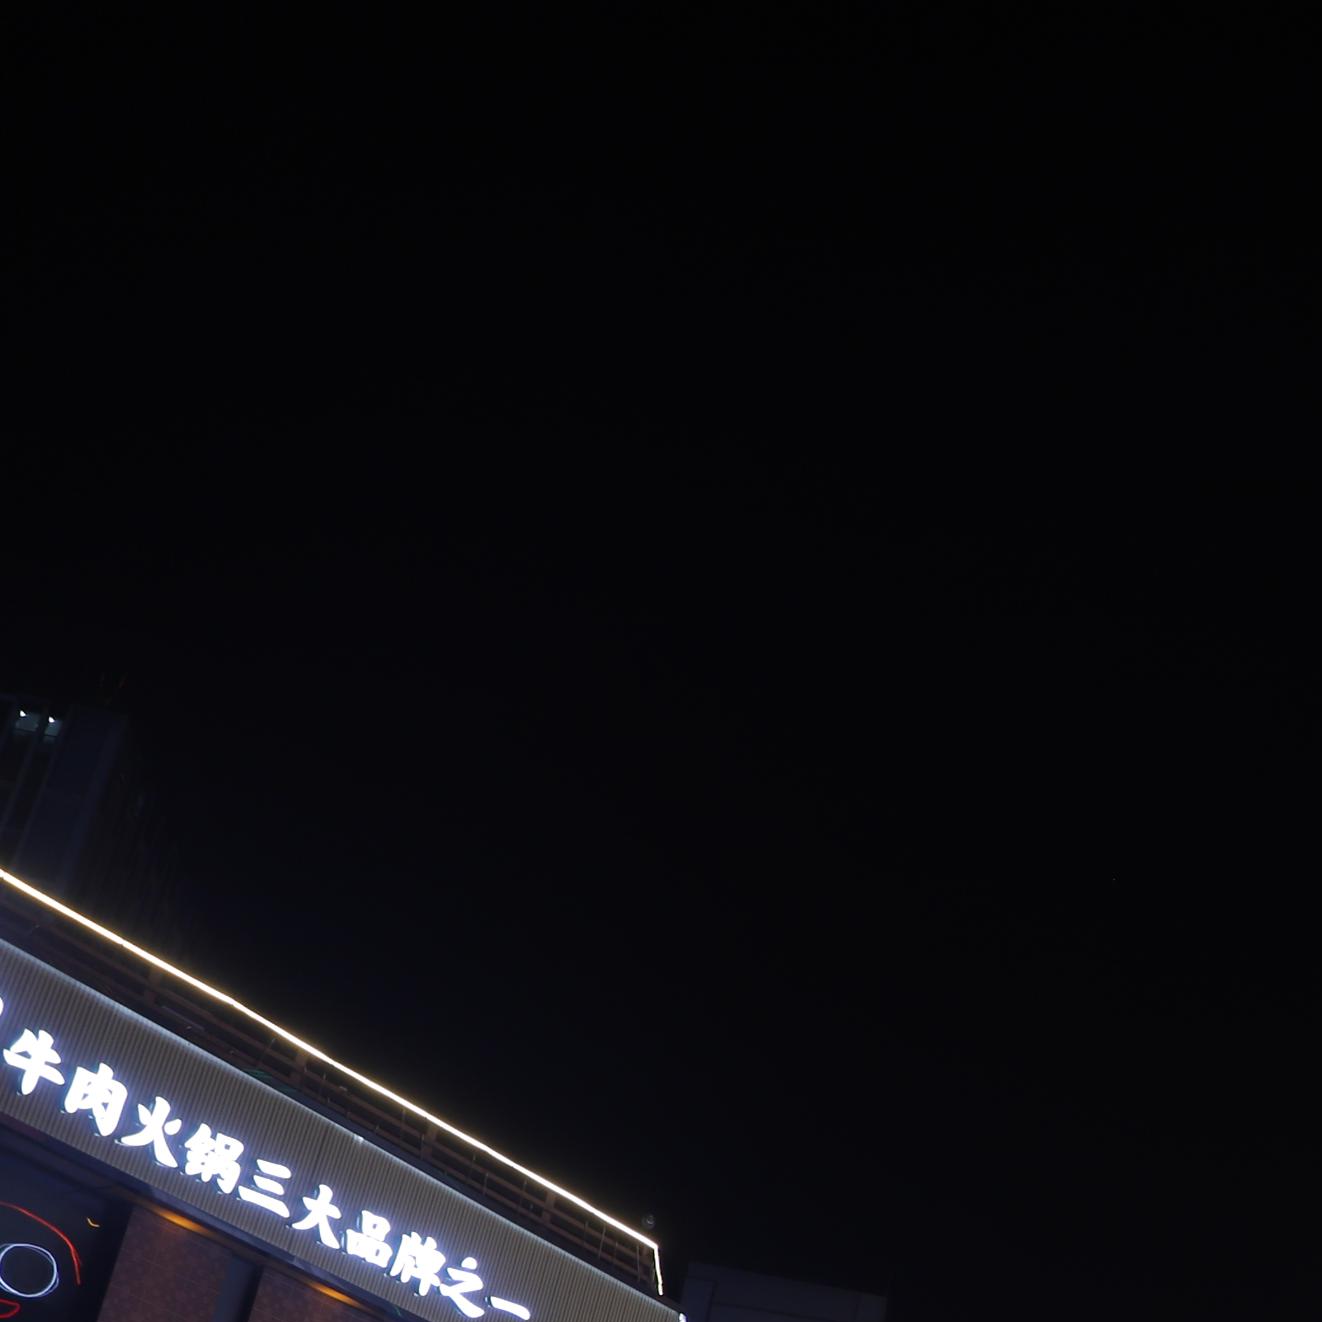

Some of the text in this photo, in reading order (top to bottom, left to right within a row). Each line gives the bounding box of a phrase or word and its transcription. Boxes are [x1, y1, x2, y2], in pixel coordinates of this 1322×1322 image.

[2, 1028, 532, 1322] 牛肉火锅三大品牌之一
